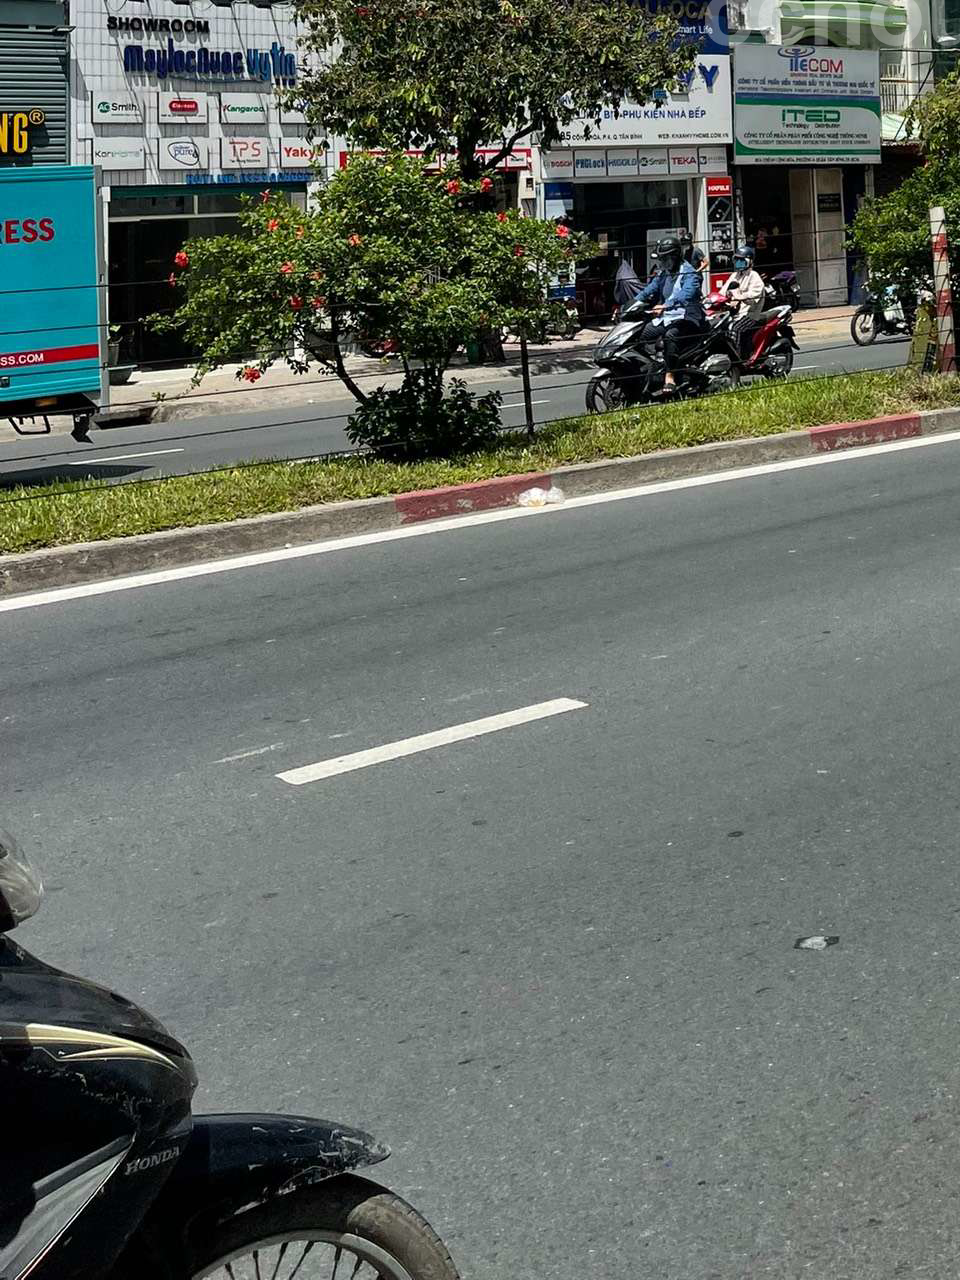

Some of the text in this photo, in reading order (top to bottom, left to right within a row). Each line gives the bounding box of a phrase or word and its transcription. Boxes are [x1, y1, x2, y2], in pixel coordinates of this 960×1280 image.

[107, 16, 211, 33] SHOWROOM
[698, 24, 714, 36] Life
[111, 103, 137, 111] Smith
[222, 104, 264, 113] Kangaroo
[229, 140, 261, 157] TPS
[672, 156, 697, 165] TEKA
[0, 218, 55, 245] ESS
[0, 352, 44, 367] SS.COM
[125, 1146, 180, 1176] HONDA
